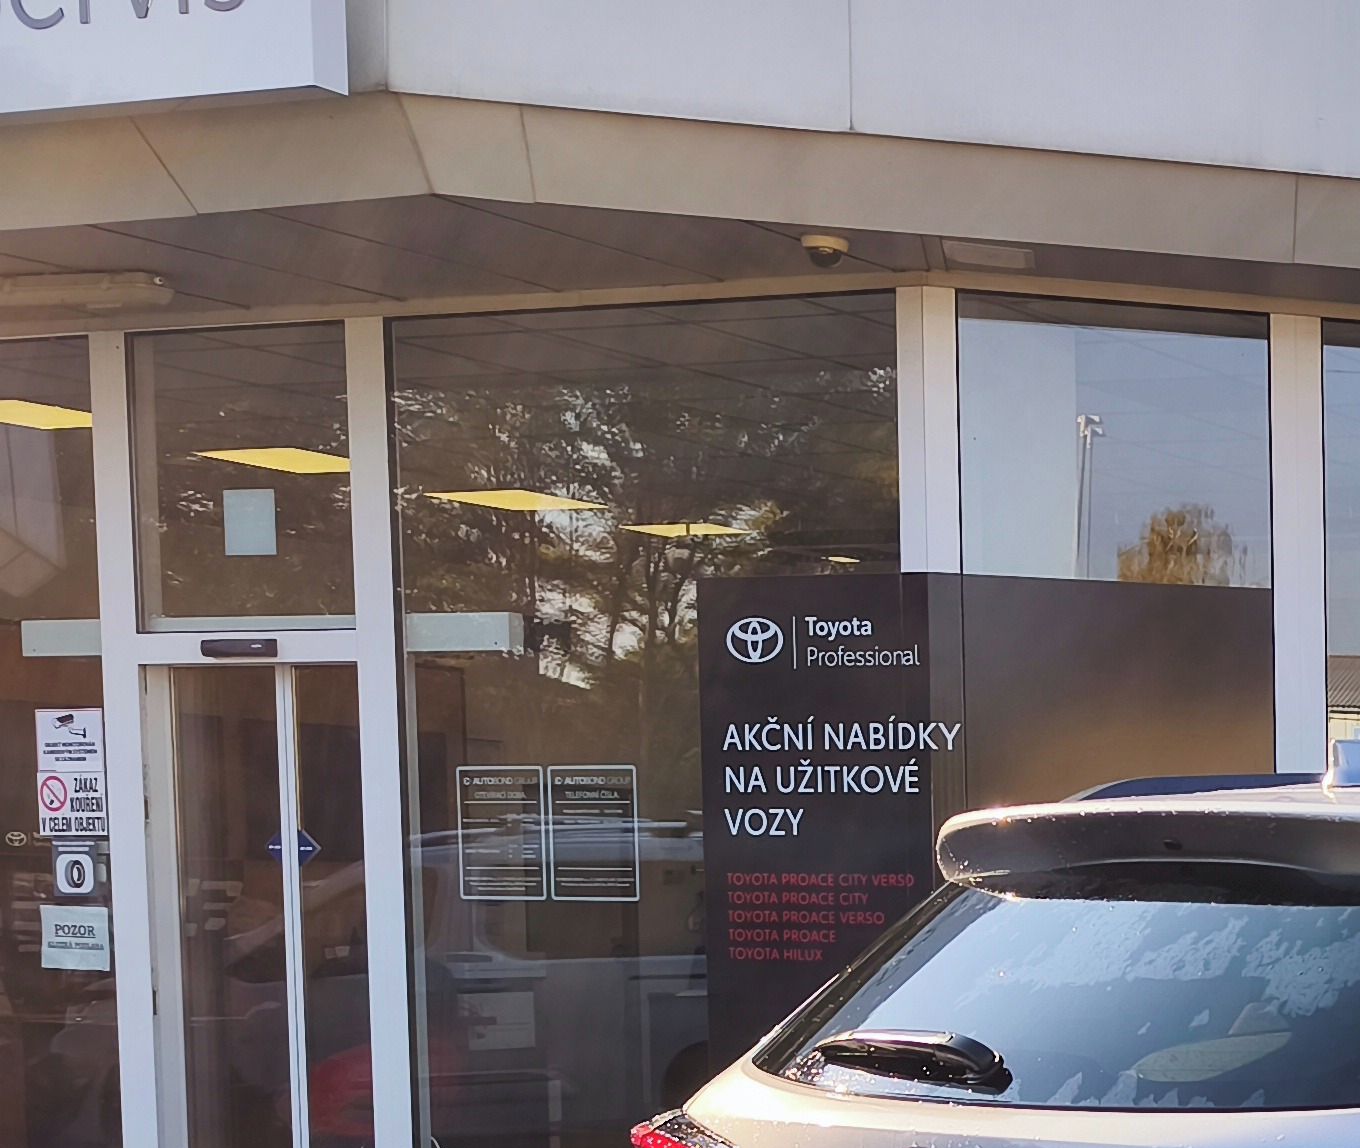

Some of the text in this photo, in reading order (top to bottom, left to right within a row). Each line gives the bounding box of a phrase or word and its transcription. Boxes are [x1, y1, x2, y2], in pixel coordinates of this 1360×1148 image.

[804, 616, 873, 641] Toyota
[806, 644, 921, 667] Professional
[723, 715, 962, 751] AKČNÍ NABÍDKY
[725, 758, 920, 794] NA UŽITKOVÉ
[41, 817, 47, 832] V
[724, 808, 804, 836] VOZY
[727, 873, 915, 887] TOYOTA PROACE CITY VERSO
[728, 891, 869, 905] TOYOTA PROACE CITY
[728, 910, 885, 924] TOYOTA PROACE VERSO
[54, 923, 97, 936] POZOR
[729, 928, 837, 942] TOYOTA PROACE
[729, 947, 823, 961] TOYOTA HILUX
